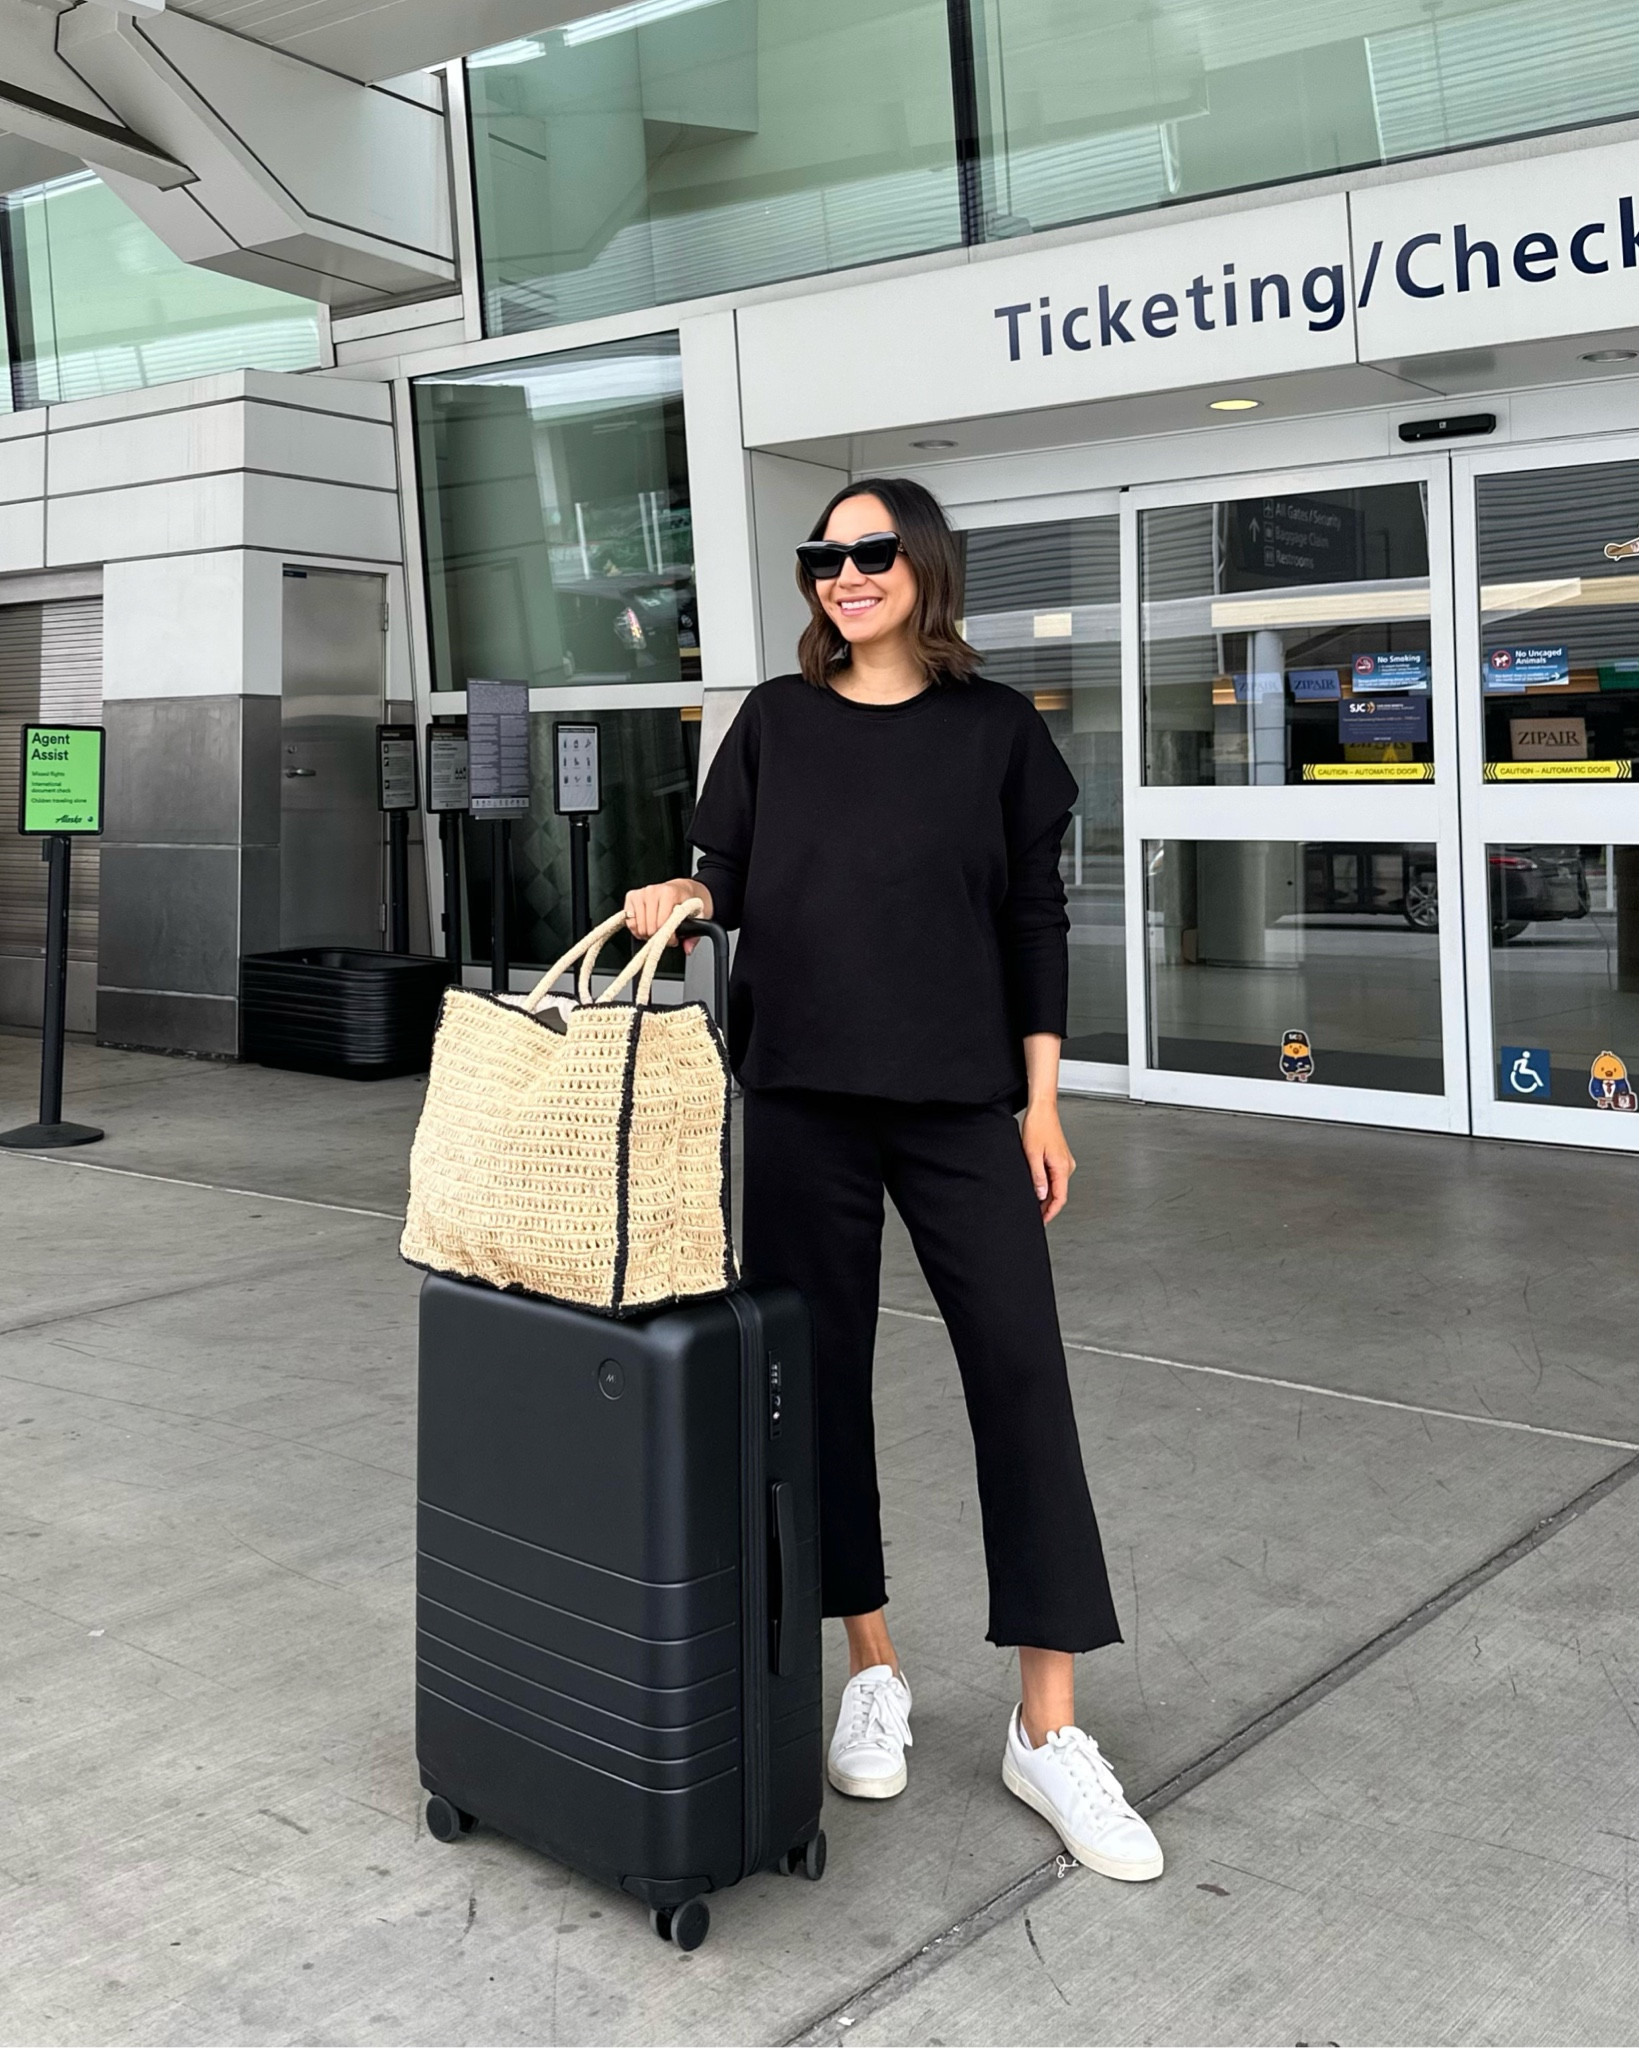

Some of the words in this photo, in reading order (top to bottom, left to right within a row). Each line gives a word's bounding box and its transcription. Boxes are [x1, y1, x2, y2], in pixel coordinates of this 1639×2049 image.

[1275, 526, 1307, 548] Baggage
[1309, 532, 1329, 549] Claim
[1276, 549, 1314, 569] Restrooms
[1390, 654, 1421, 663] Smoking
[1515, 650, 1527, 658] No
[1528, 648, 1562, 658] Uncaged
[1515, 657, 1547, 665] Animals
[1294, 678, 1336, 691] ZIPAIR
[1349, 702, 1366, 713] SJC
[31, 732, 70, 747] Agent
[1517, 730, 1581, 746] ZIPAIR
[31, 748, 69, 761] Assist
[1318, 768, 1348, 776] CAUTION
[1355, 768, 1395, 776] AUTOMATIC
[1397, 767, 1418, 775] DOOR
[1500, 767, 1534, 775] CAUTION
[1541, 766, 1586, 774] AUTOMATIC
[1587, 766, 1611, 774] DOOR
